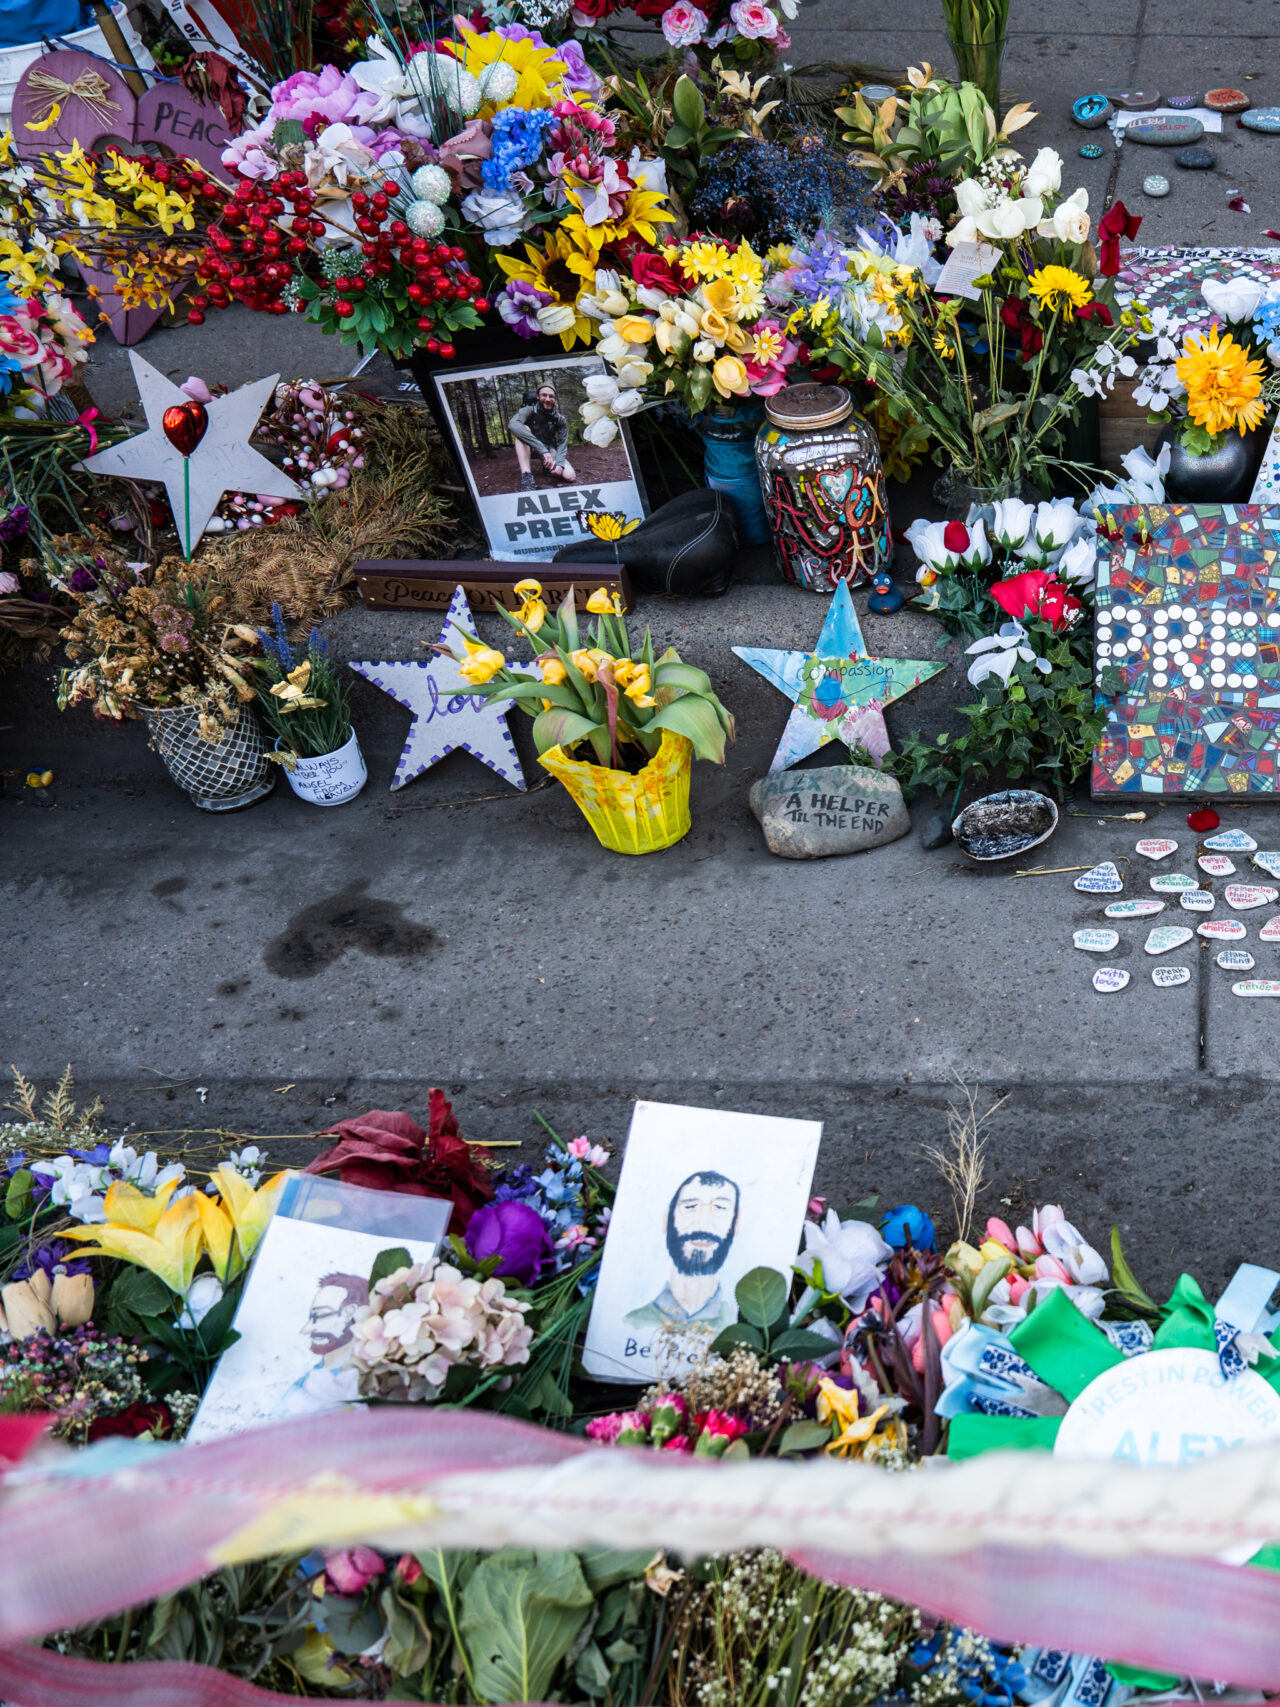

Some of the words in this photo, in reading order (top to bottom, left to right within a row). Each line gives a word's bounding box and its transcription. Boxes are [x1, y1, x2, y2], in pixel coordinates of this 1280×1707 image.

[155, 102, 228, 148] PEAC
[517, 488, 606, 516] ALEX
[426, 675, 484, 723] lov
[786, 793, 802, 809] A
[811, 793, 890, 817] HELPER
[814, 813, 847, 829] THE
[851, 816, 884, 834] END
[624, 1337, 652, 1359] Be
[1089, 1370, 1150, 1417] REST
[1157, 1365, 1185, 1385] IN
[1192, 1366, 1278, 1429] POWER
